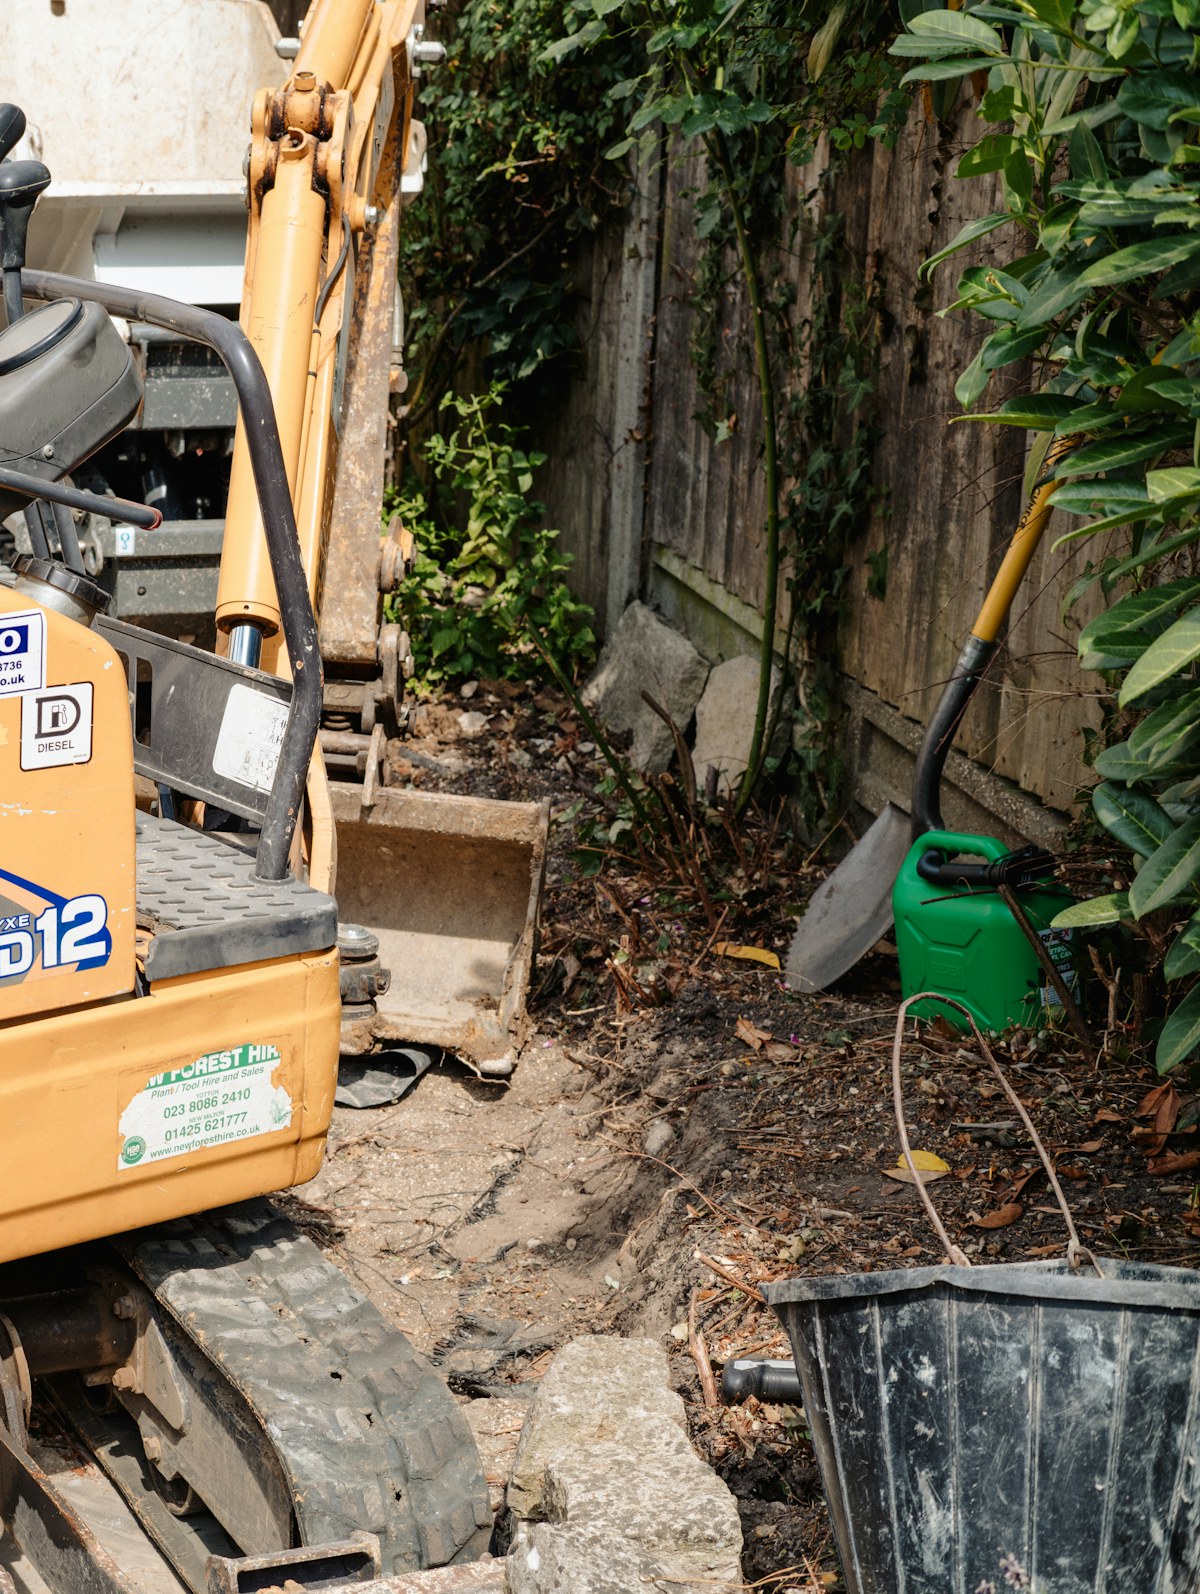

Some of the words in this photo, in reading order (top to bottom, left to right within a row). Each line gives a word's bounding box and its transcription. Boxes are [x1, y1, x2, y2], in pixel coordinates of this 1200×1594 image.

[37, 740, 75, 753] DIESEL
[170, 1047, 244, 1082] FOREST
[247, 1044, 281, 1064] HIR
[151, 1087, 174, 1100] Plant
[181, 1081, 200, 1092] Tool
[201, 1076, 221, 1088] Hire
[222, 1073, 239, 1083] and
[240, 1066, 265, 1078] Sales
[196, 1089, 220, 1099] TOTTON
[163, 1105, 186, 1119] 023
[189, 1096, 219, 1113] 8086
[221, 1088, 251, 1105] 2410
[188, 1115, 202, 1124] NEW
[203, 1110, 225, 1121] MILTON
[150, 1124, 261, 1159] www.newforesthire.co.uk
[164, 1124, 201, 1142] 01425
[203, 1112, 248, 1132] 621777
